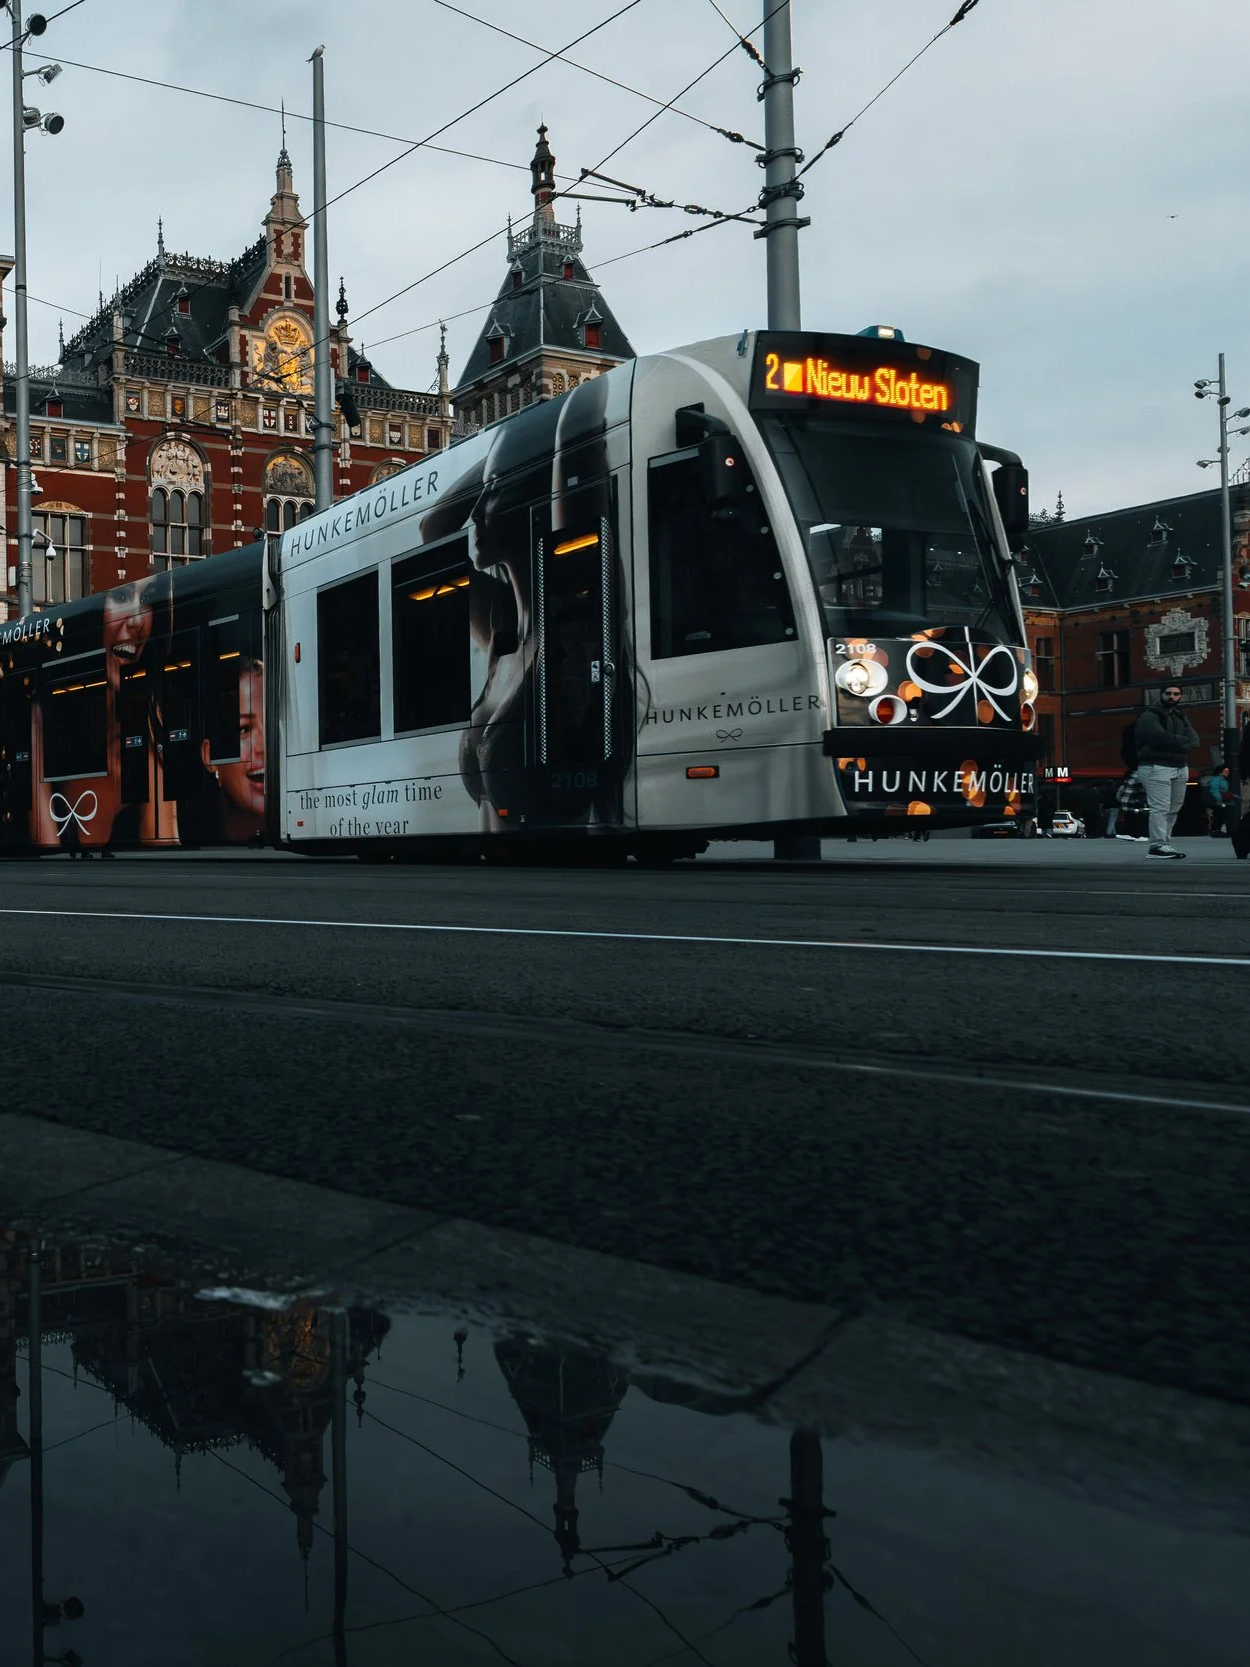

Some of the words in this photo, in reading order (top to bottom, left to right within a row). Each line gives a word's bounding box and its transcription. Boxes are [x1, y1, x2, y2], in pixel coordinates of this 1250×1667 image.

[765, 353, 779, 390] 2
[806, 358, 870, 400] Nieuw
[874, 367, 948, 411] Sloten
[291, 470, 439, 557] HUNKEMÖLLER
[835, 643, 877, 655] 2108
[645, 694, 821, 726] HUNKEMÖLLER
[854, 764, 1034, 793] HUNKEMÖLLER
[1057, 767, 1069, 778] M
[300, 791, 320, 810] the
[324, 789, 358, 809] most
[362, 785, 399, 810] glam
[404, 782, 442, 802] time
[330, 817, 345, 837] of
[347, 816, 371, 836] the
[375, 819, 409, 836] year
